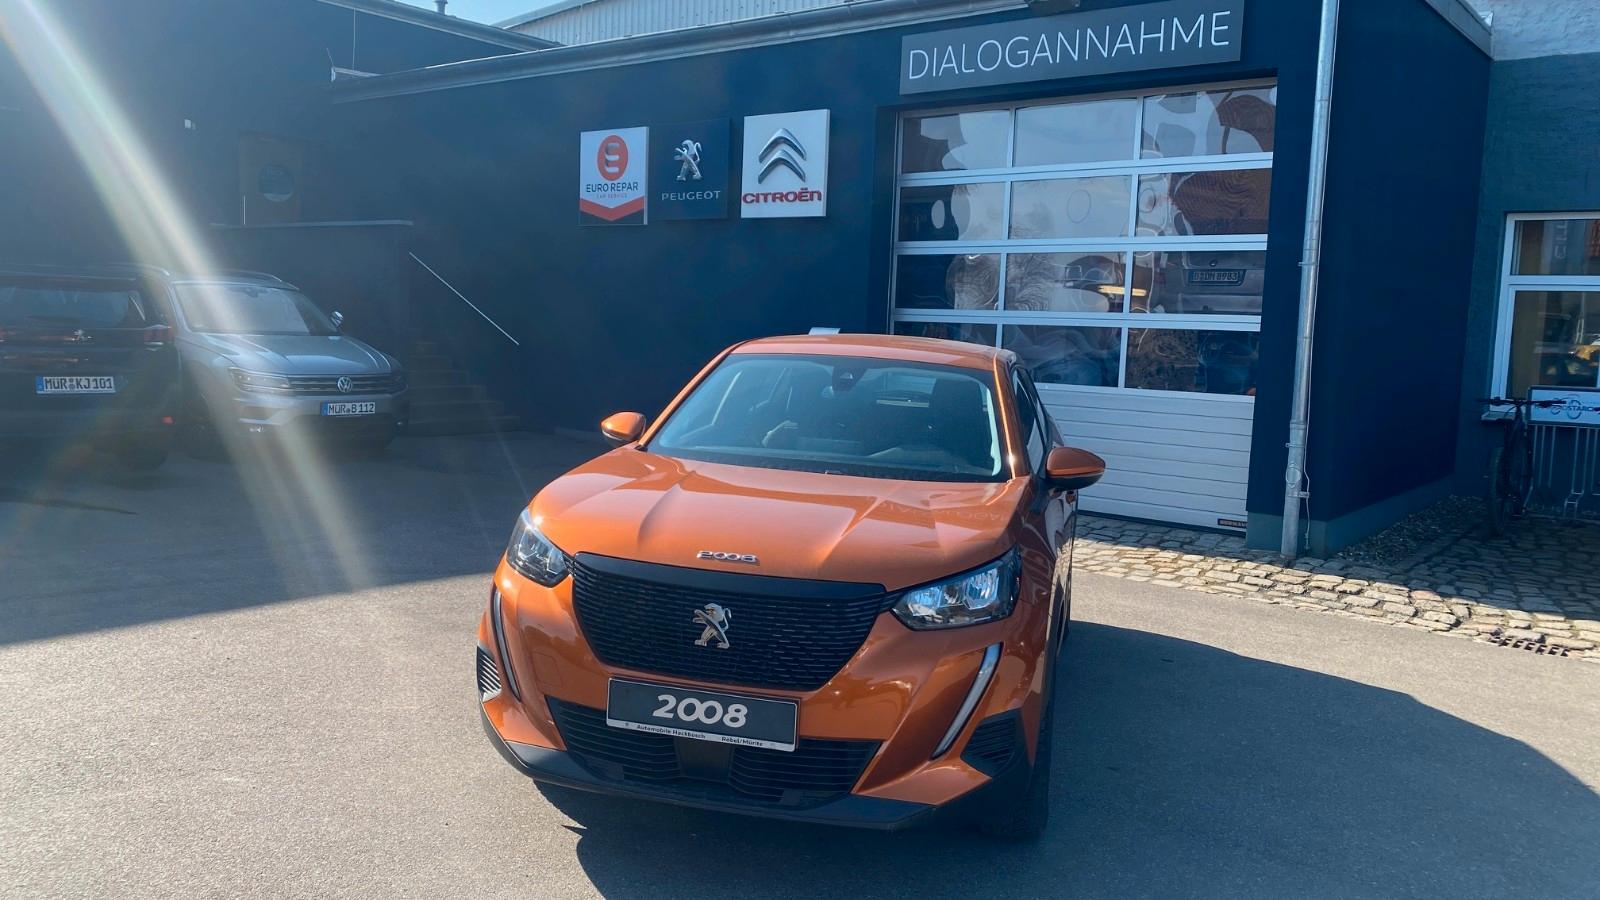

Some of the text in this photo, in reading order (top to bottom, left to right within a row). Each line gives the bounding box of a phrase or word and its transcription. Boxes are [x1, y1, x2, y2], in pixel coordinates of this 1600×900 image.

[909, 10, 1231, 80] DIALOGANNAHME
[586, 181, 639, 193] EURO REPAR
[661, 190, 721, 201] PEUGEOT
[696, 550, 758, 563] 2008
[652, 694, 748, 728] 2008
